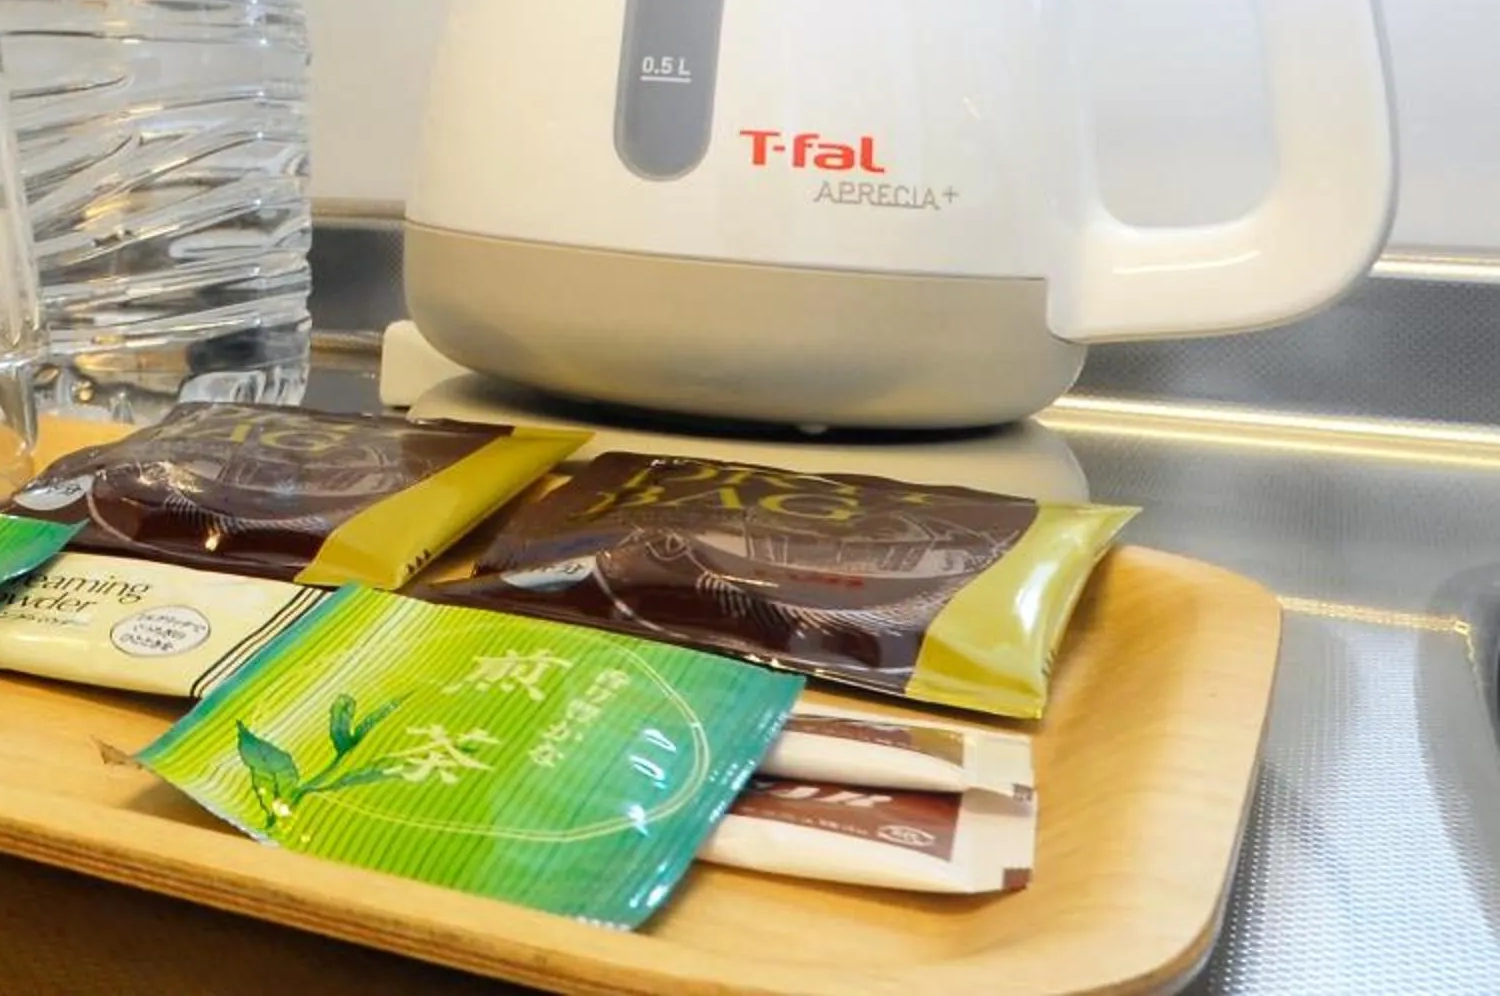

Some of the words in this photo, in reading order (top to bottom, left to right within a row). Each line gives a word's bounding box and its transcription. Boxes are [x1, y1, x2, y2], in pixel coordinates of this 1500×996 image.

[642, 56, 673, 75] 0.5
[678, 57, 692, 76] L
[739, 129, 886, 174] T-fal
[21, 574, 151, 604] eaming
